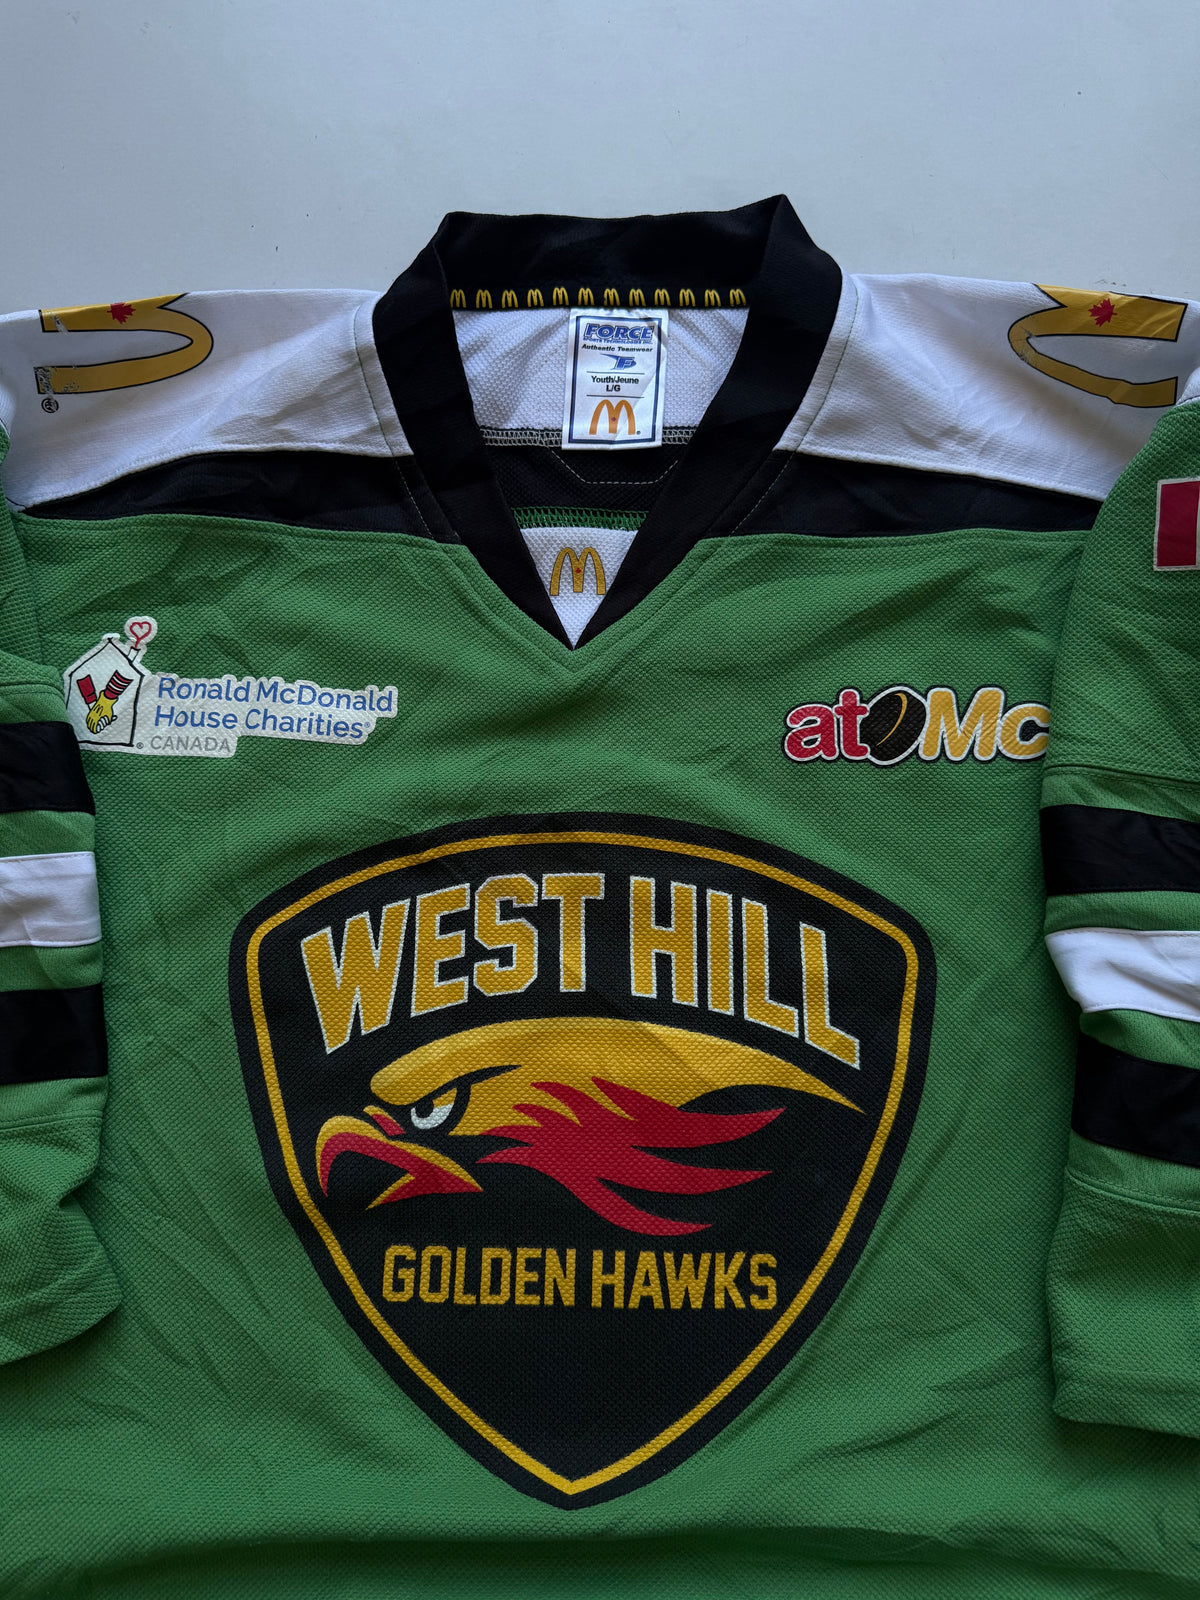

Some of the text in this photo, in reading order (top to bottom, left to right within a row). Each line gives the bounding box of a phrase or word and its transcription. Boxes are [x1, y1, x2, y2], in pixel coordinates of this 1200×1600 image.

[583, 322, 655, 341] FORCE
[581, 343, 616, 352] Authentic
[591, 375, 640, 385] Youth/Jeune
[606, 384, 621, 392] L/G
[158, 677, 394, 712] Ronald McDonald
[154, 705, 238, 729] House
[150, 734, 232, 754] CANADA
[300, 872, 861, 1070] WEST HILL
[382, 1244, 778, 1310] GOLDEN HAWKS
